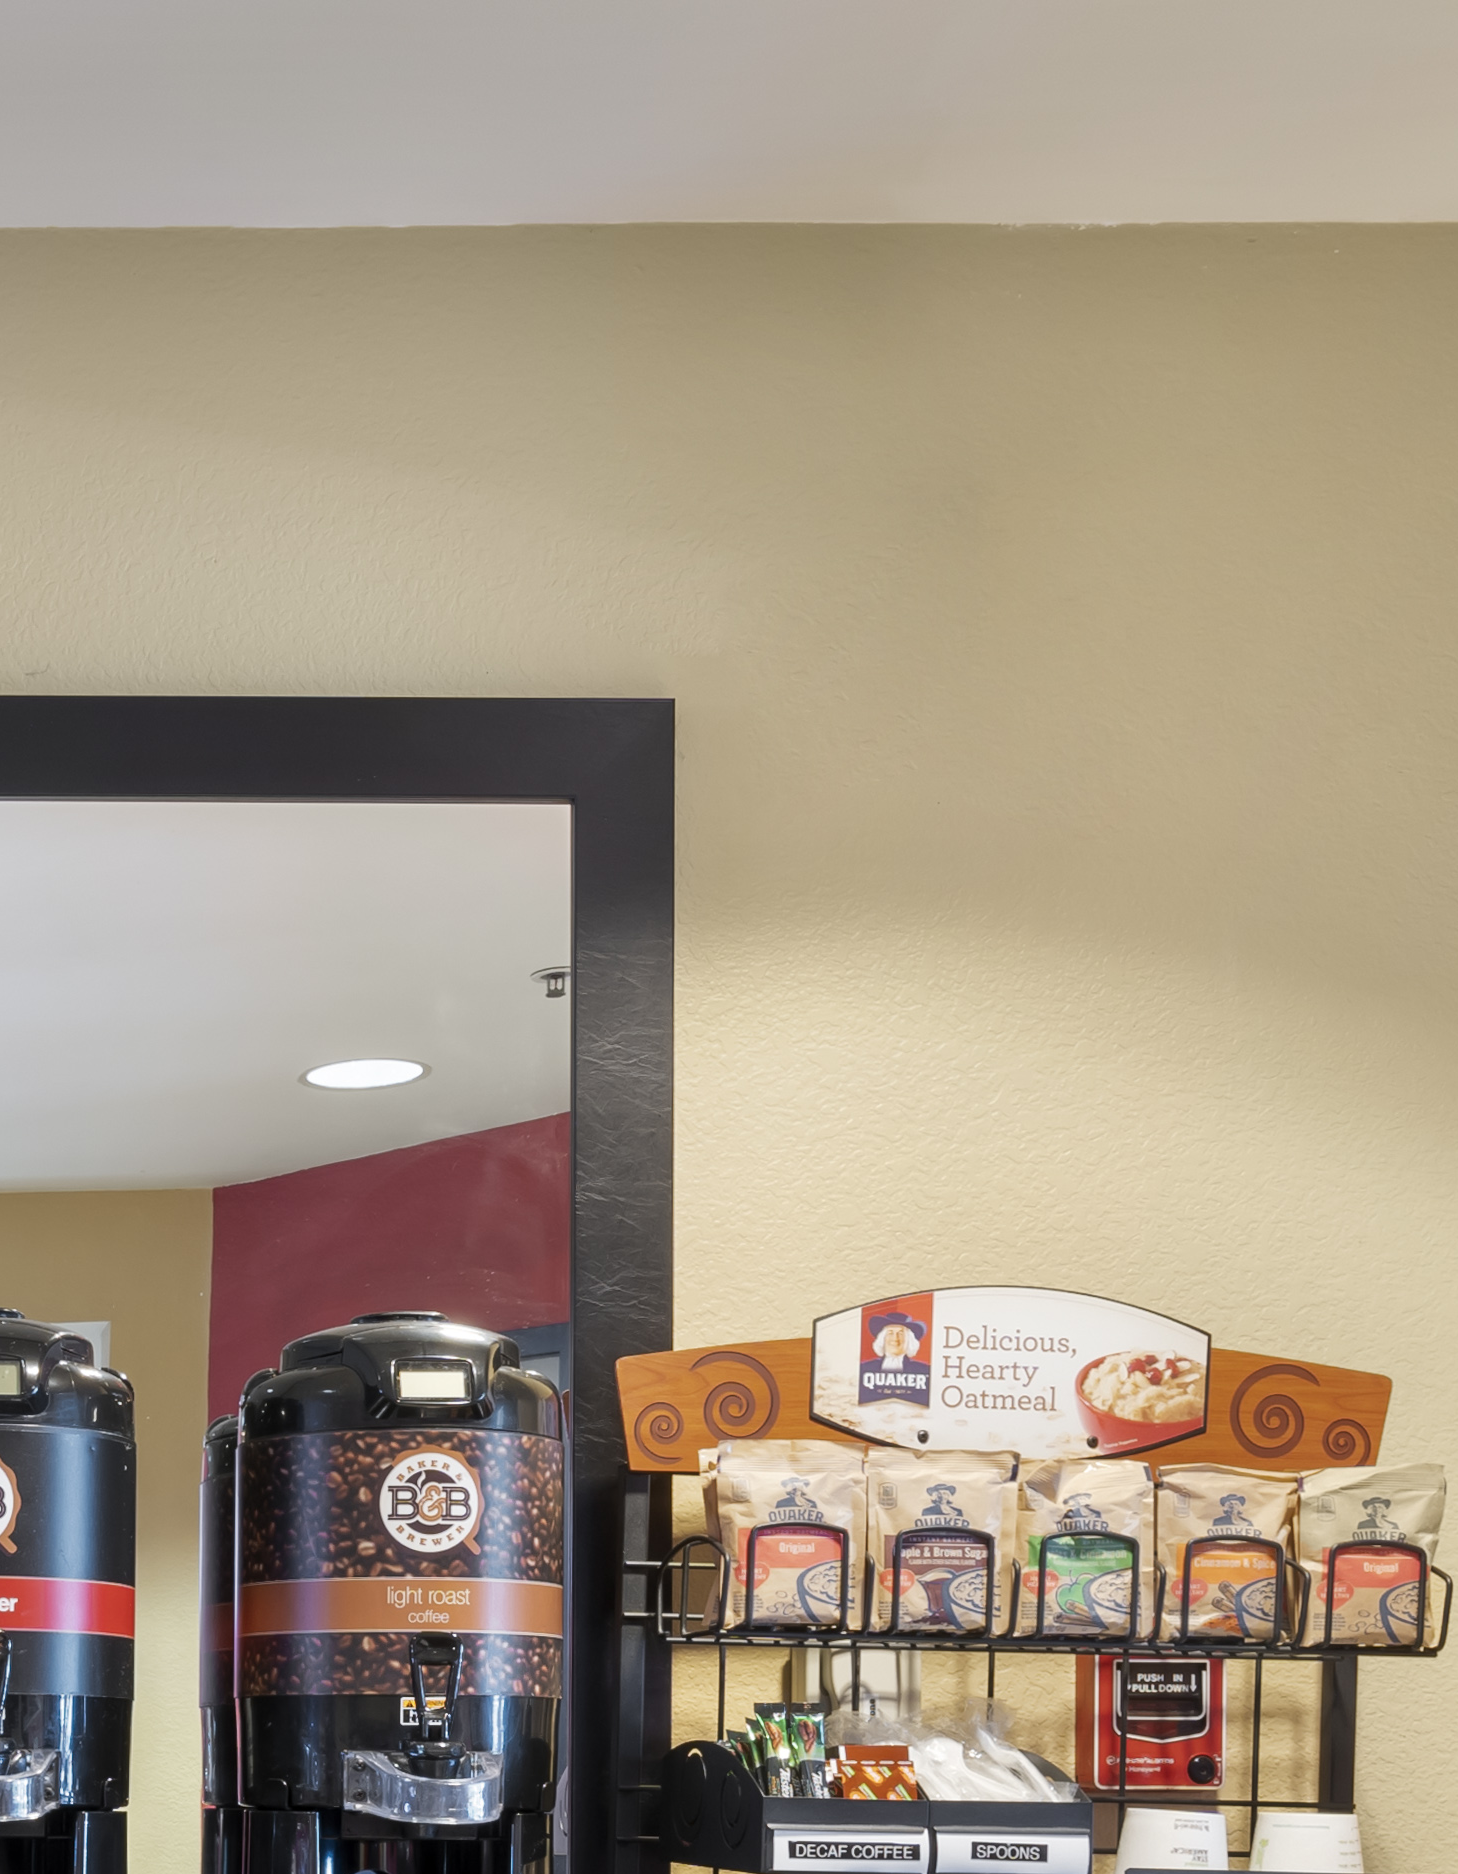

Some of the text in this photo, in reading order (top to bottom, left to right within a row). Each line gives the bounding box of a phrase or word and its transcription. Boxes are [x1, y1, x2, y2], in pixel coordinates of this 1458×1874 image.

[943, 1325, 1077, 1358] Delicious,
[941, 1356, 1040, 1387] Hearty
[863, 1372, 927, 1390] QUAKER
[940, 1385, 1058, 1412] Oatmeal
[396, 1458, 451, 1482] BAKER
[387, 1484, 472, 1522] B&B
[768, 1509, 825, 1523] QUAKER
[395, 1523, 466, 1546] BREWER
[779, 1542, 816, 1555] Original
[923, 1547, 963, 1558] & Brown
[1194, 1557, 1276, 1570] Cinnamon & Spice
[1363, 1562, 1399, 1575] Original
[387, 1586, 471, 1609] light roast
[407, 1610, 450, 1624] coffee
[1137, 1673, 1184, 1682] PUSH IN
[1131, 1684, 1189, 1693] PULL DOWN
[795, 1844, 913, 1859] DECAF COFFEE
[976, 1845, 1040, 1861] SPOONS
